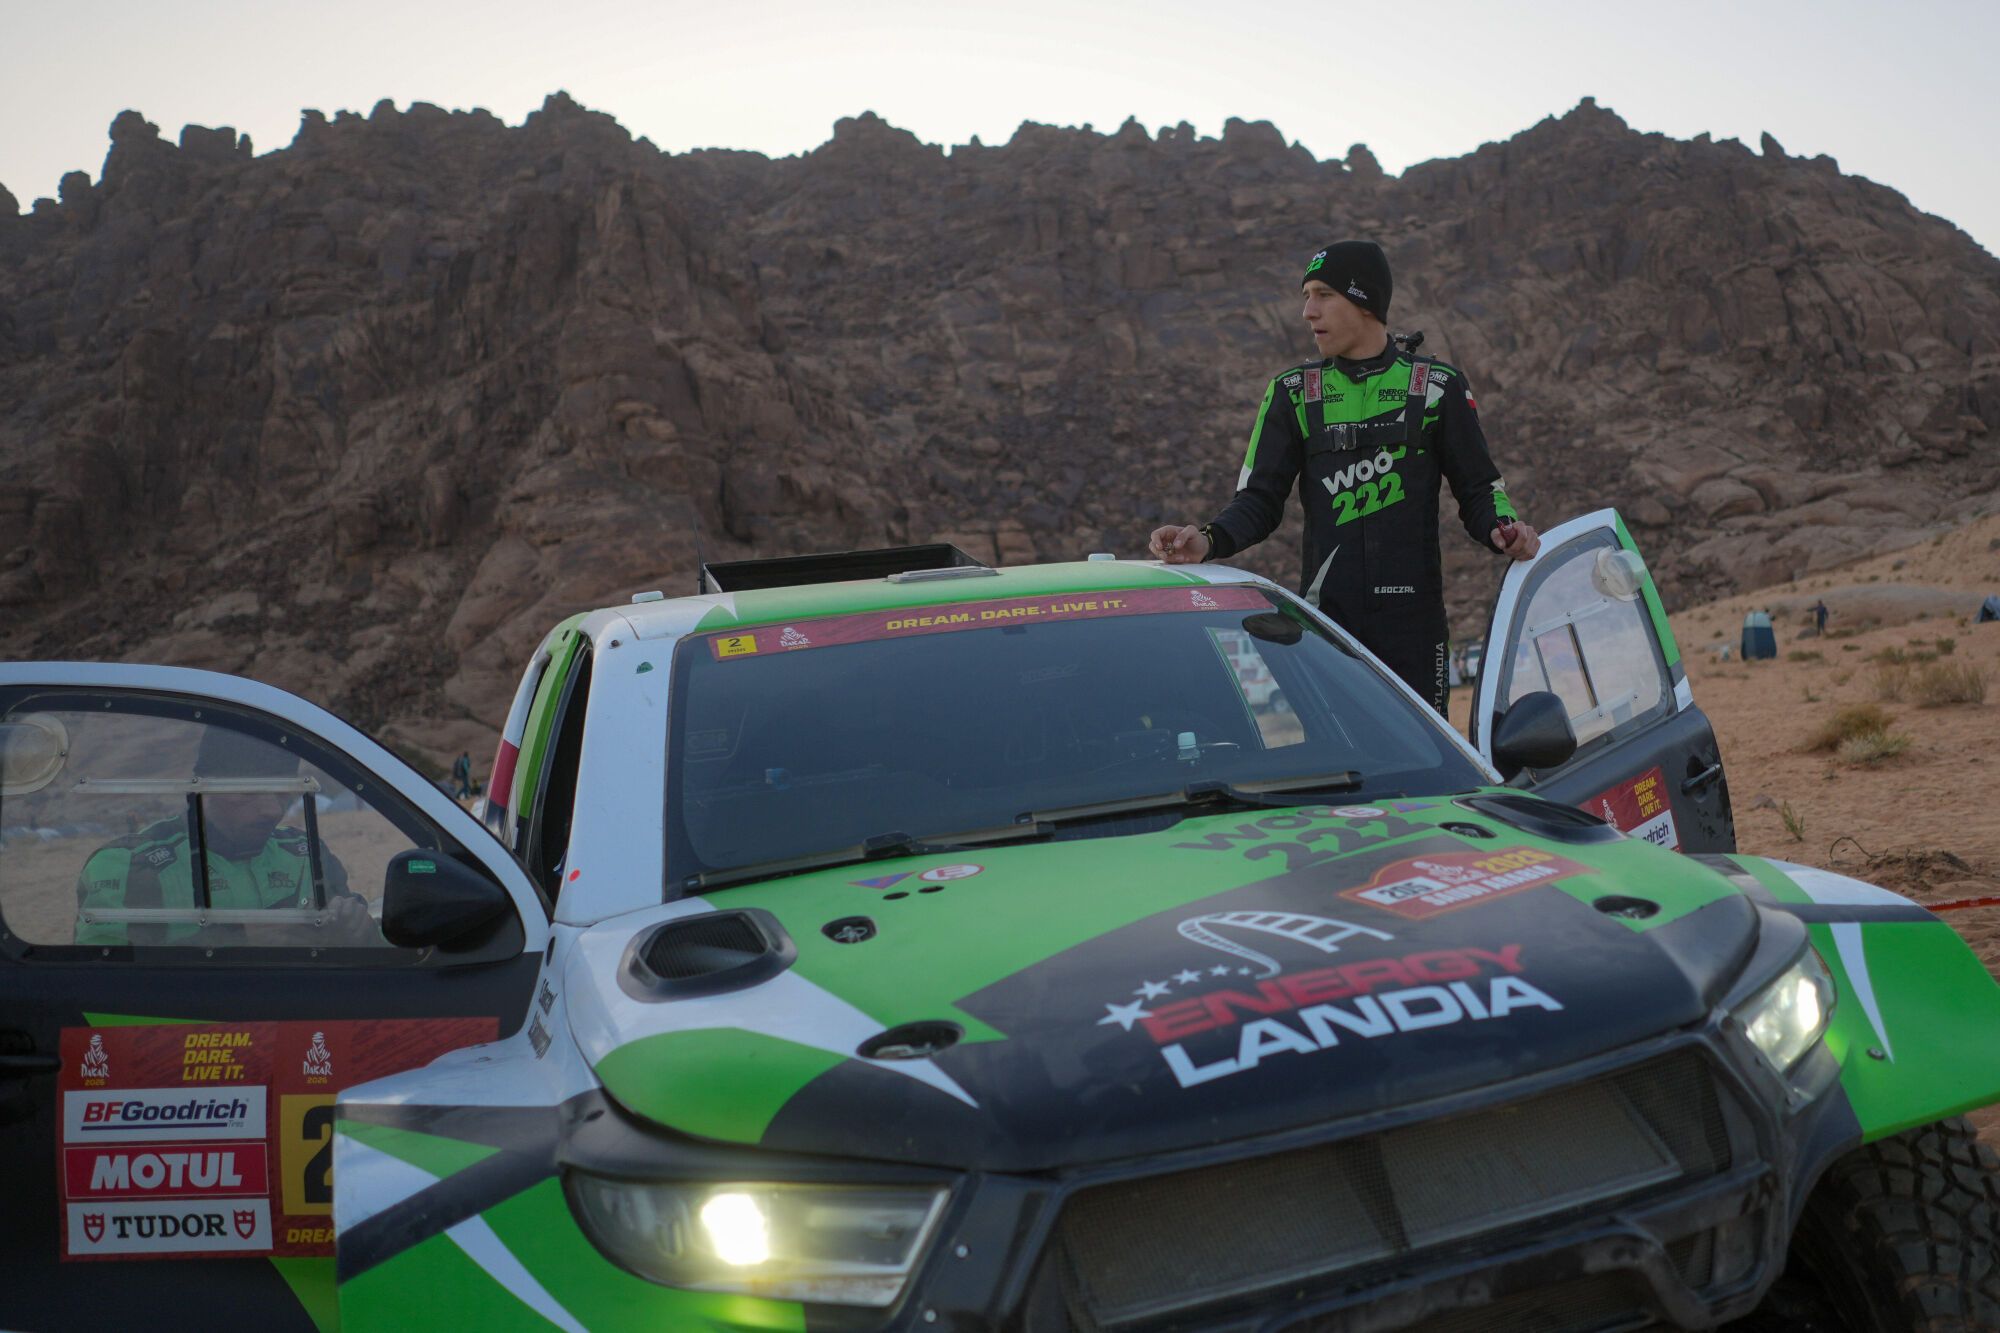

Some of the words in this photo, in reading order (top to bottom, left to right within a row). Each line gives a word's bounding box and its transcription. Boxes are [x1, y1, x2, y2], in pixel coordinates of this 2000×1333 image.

[1322, 451, 1394, 496] WOO
[1332, 472, 1406, 527] 222
[886, 613, 976, 631] DREAM.
[980, 606, 1047, 621] DARE.
[1051, 601, 1098, 614] LIVE
[1103, 599, 1128, 609] IT.
[727, 638, 742, 648] 2
[1633, 776, 1657, 795] DREAM.
[1138, 943, 1527, 1045] ENERGY
[184, 1032, 253, 1048] DREAM.
[1161, 975, 1566, 1089] LANDIA
[183, 1049, 236, 1065] DARE.
[80, 1063, 110, 1078] DAKAR
[182, 1065, 223, 1081] LIVE
[225, 1065, 245, 1080] IT.
[303, 1061, 333, 1076] DAKAR
[83, 1098, 248, 1123] BFGoodrich
[89, 1151, 243, 1190] MOTUL
[112, 1213, 228, 1239] TUDOR
[286, 1228, 337, 1244] DREA
